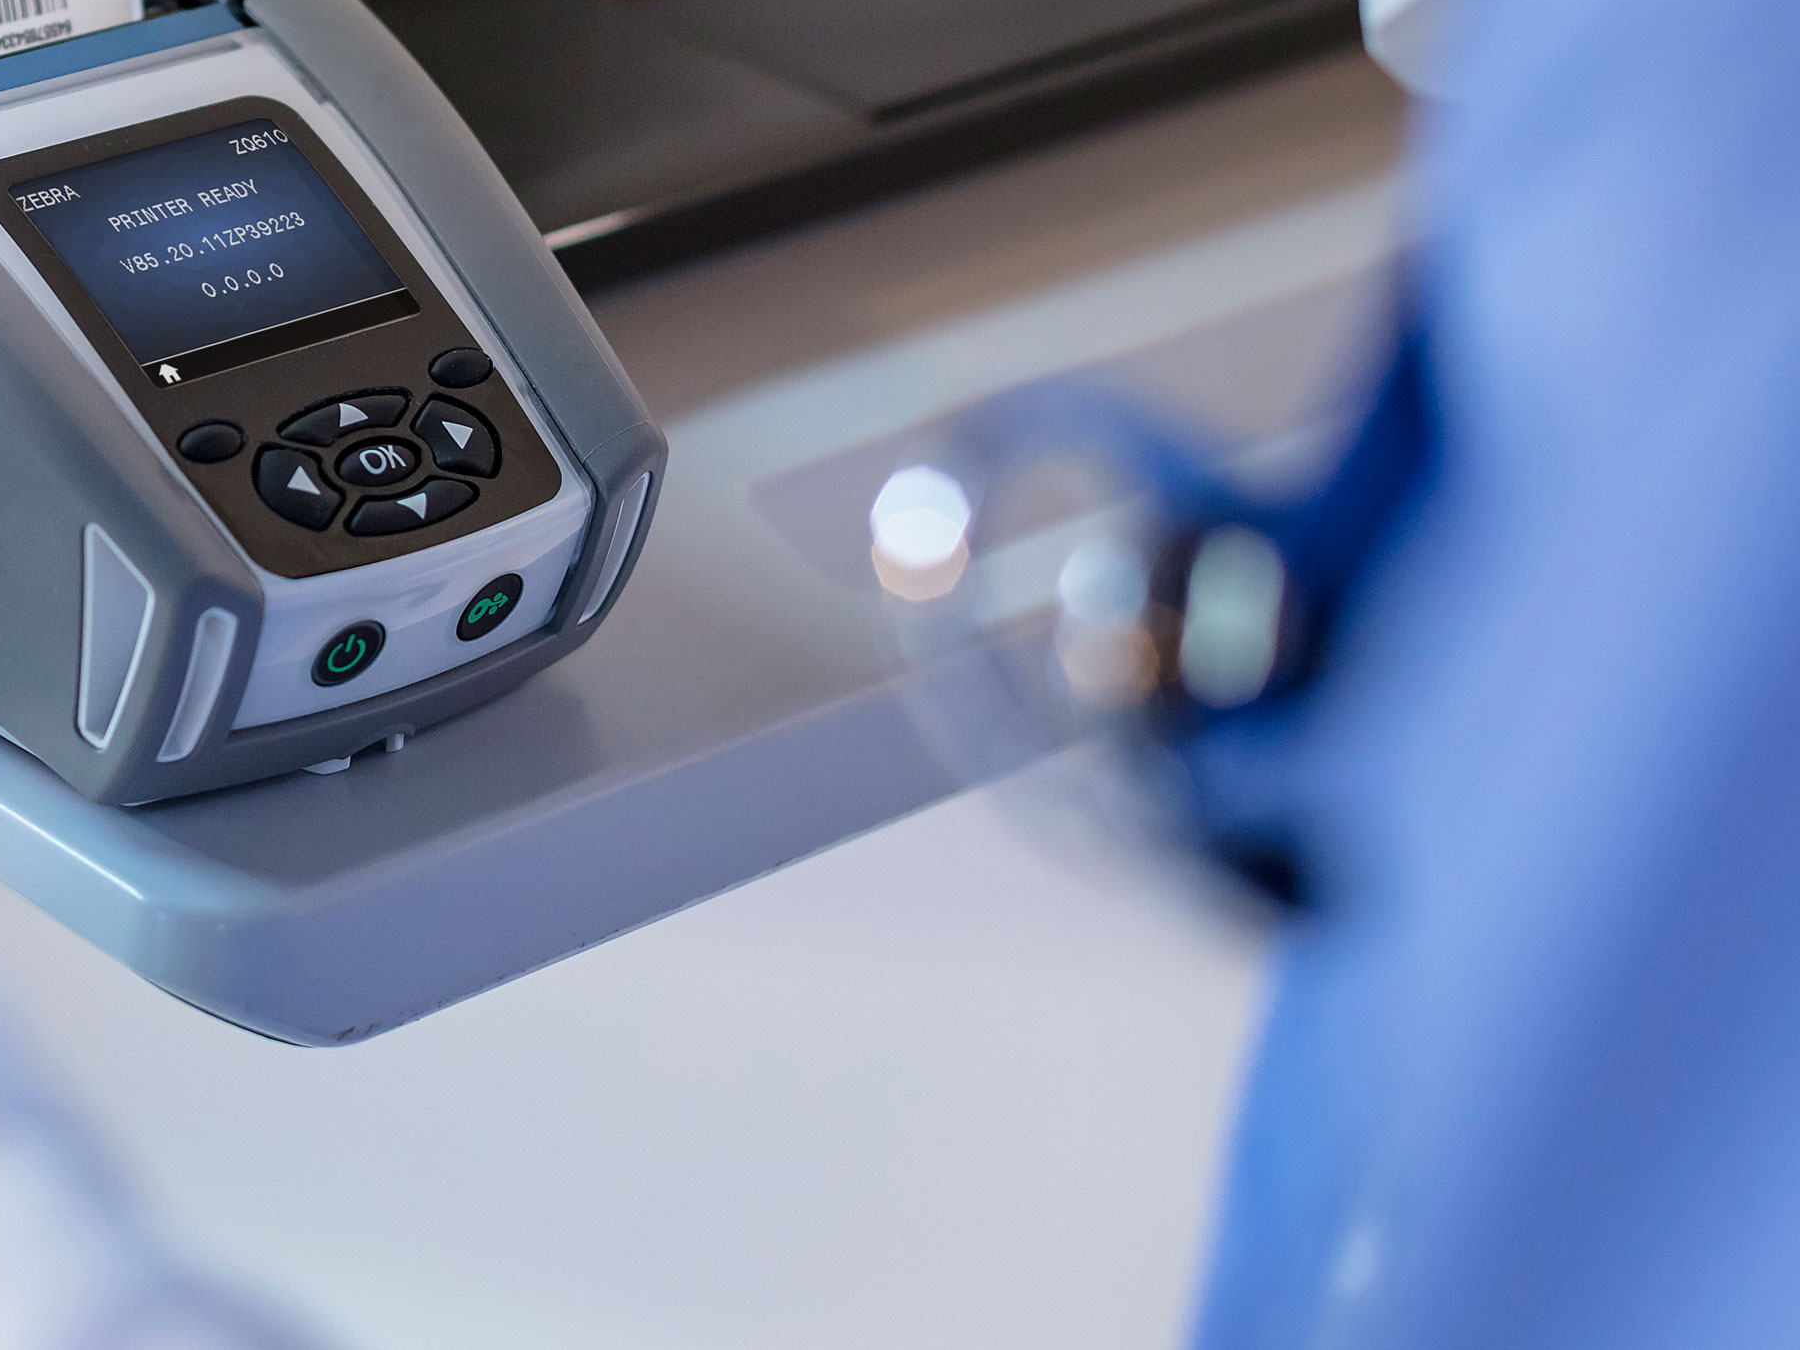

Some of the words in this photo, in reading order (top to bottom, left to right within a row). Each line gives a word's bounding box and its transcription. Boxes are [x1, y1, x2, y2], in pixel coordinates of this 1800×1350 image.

[229, 128, 288, 156] ZQ610
[15, 183, 81, 213] ZEBRA
[108, 196, 193, 234] PRINTER
[198, 178, 260, 211] READY
[201, 262, 285, 300] 0.0.0.0
[359, 445, 407, 476] OK
